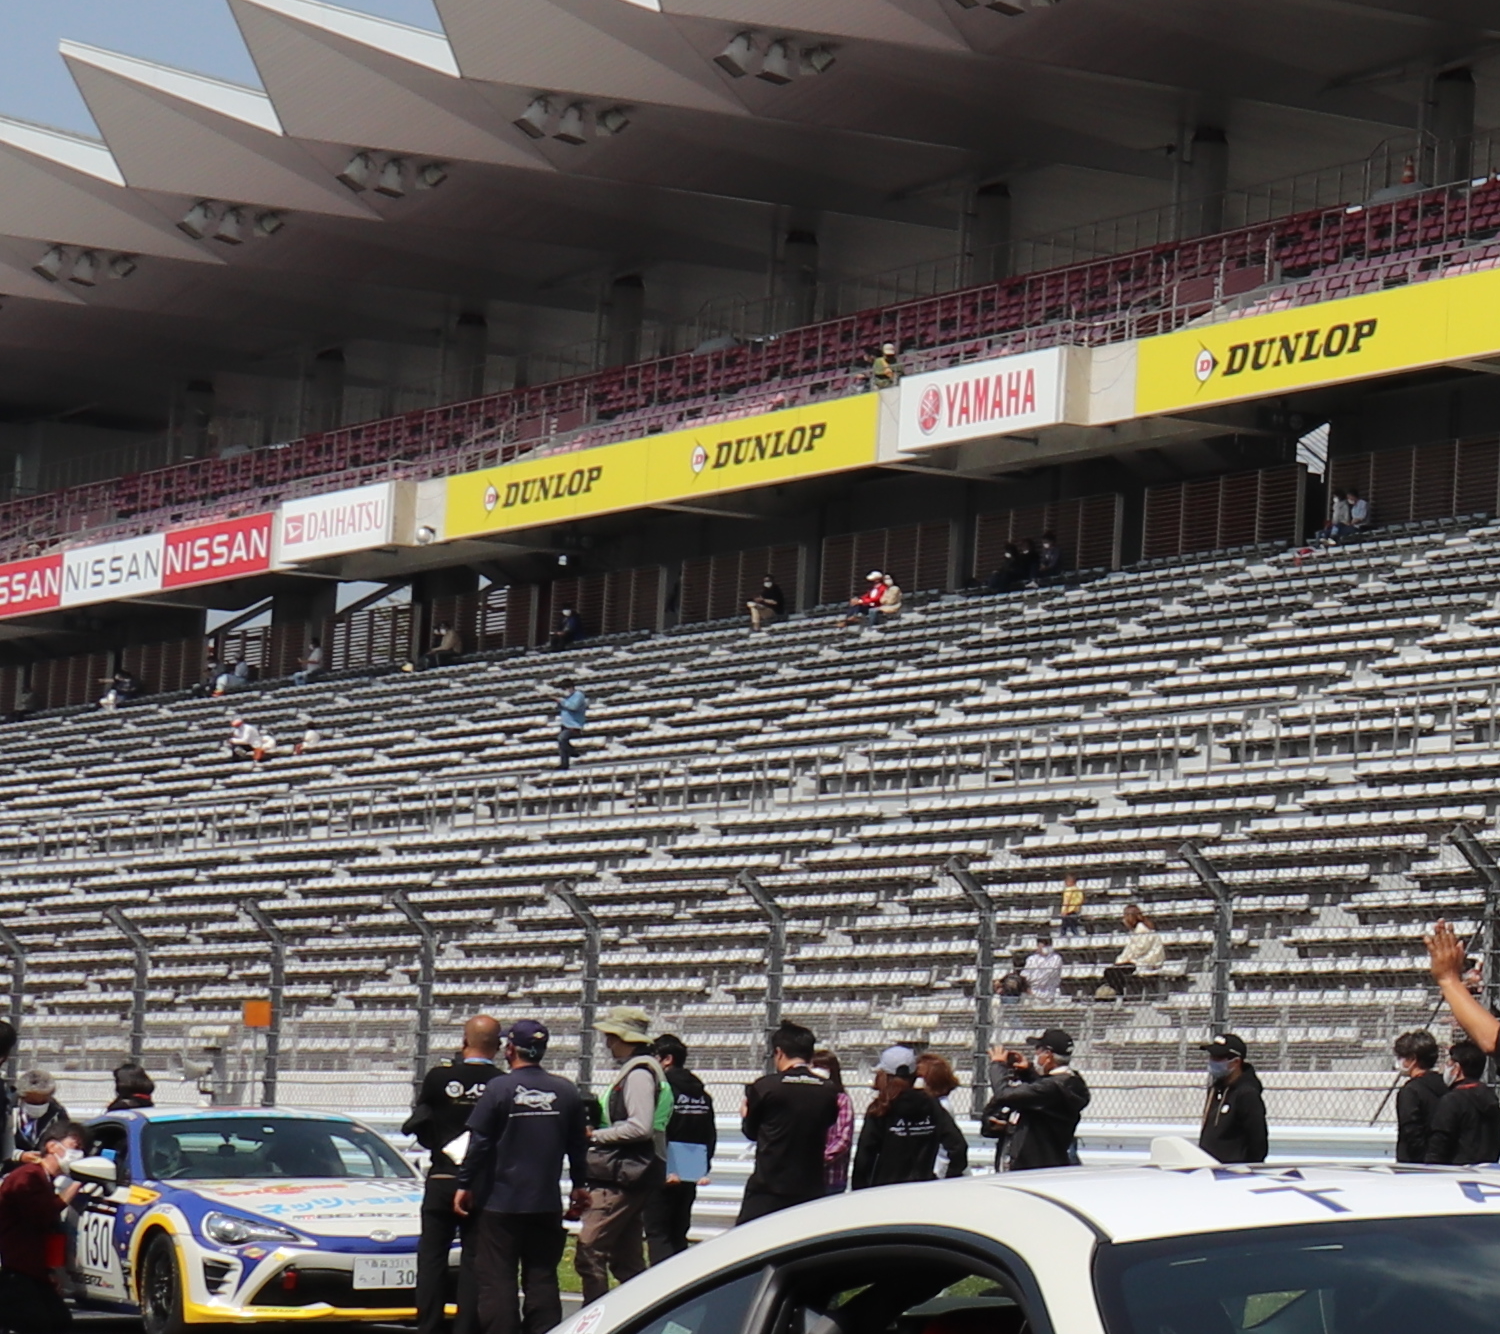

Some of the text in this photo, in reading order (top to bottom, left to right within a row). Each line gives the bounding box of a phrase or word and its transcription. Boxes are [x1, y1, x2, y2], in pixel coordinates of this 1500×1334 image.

[1222, 318, 1377, 376] DUNLOP
[946, 368, 1036, 428] YAMAHA
[712, 423, 826, 469] DUNLOP
[502, 466, 602, 508] DUNLOP
[308, 499, 385, 542] DAIHATSU
[65, 549, 160, 592] NISSAN
[166, 526, 268, 575] NISSAN
[84, 1218, 109, 1269] 130
